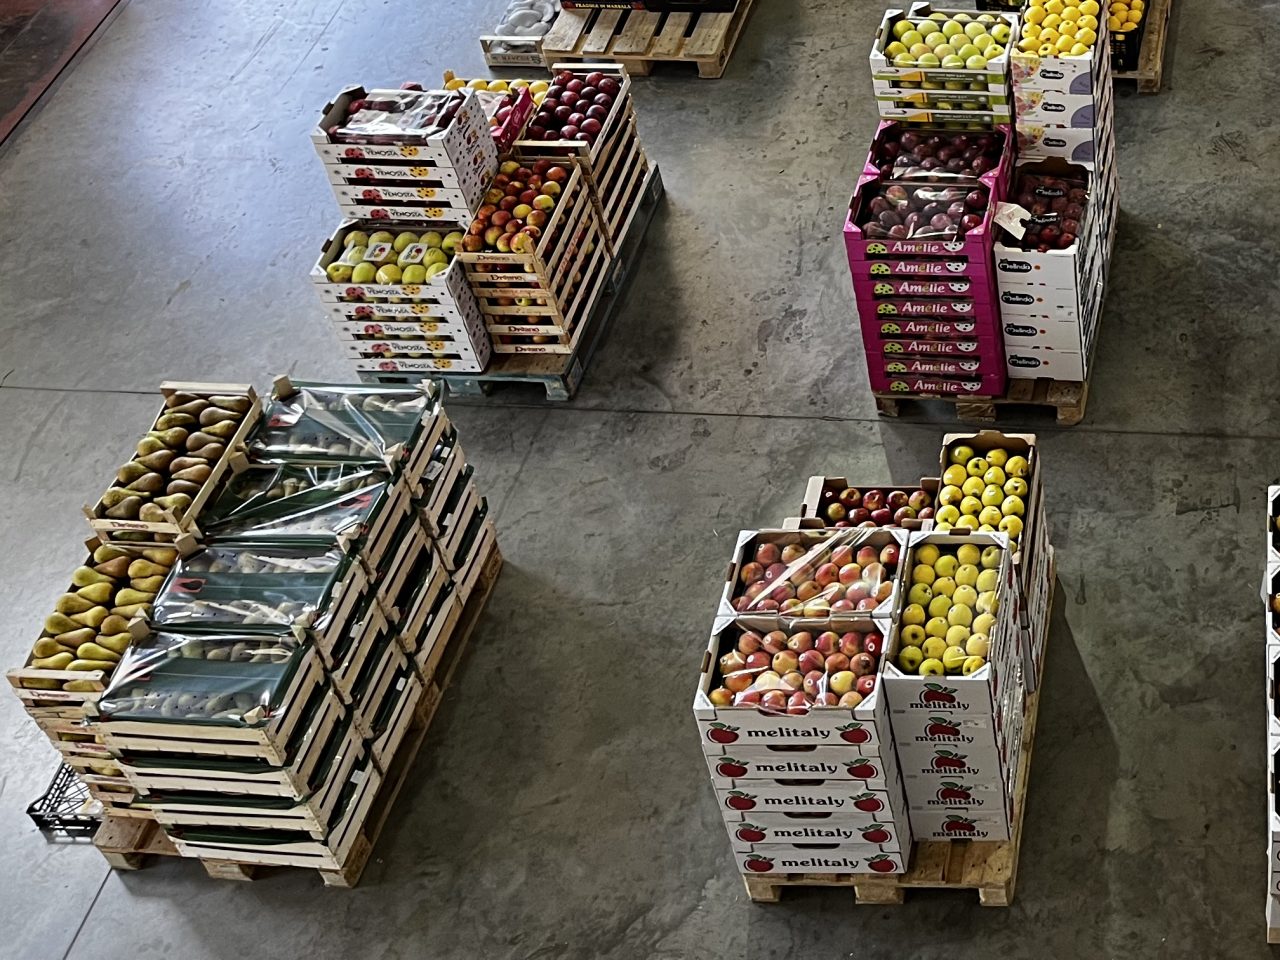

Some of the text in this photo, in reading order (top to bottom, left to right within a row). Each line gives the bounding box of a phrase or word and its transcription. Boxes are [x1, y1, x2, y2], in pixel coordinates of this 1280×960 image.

[910, 700, 970, 711] melitaly
[747, 726, 831, 740] melitaly
[915, 733, 974, 744] melitaly
[756, 761, 838, 775] melitaly
[921, 766, 980, 776] melitaly
[764, 794, 845, 808] melitaly
[927, 797, 984, 807] melitaly
[773, 826, 853, 840] melitaly
[933, 829, 989, 839] melitaly
[781, 856, 859, 869] melitaly
